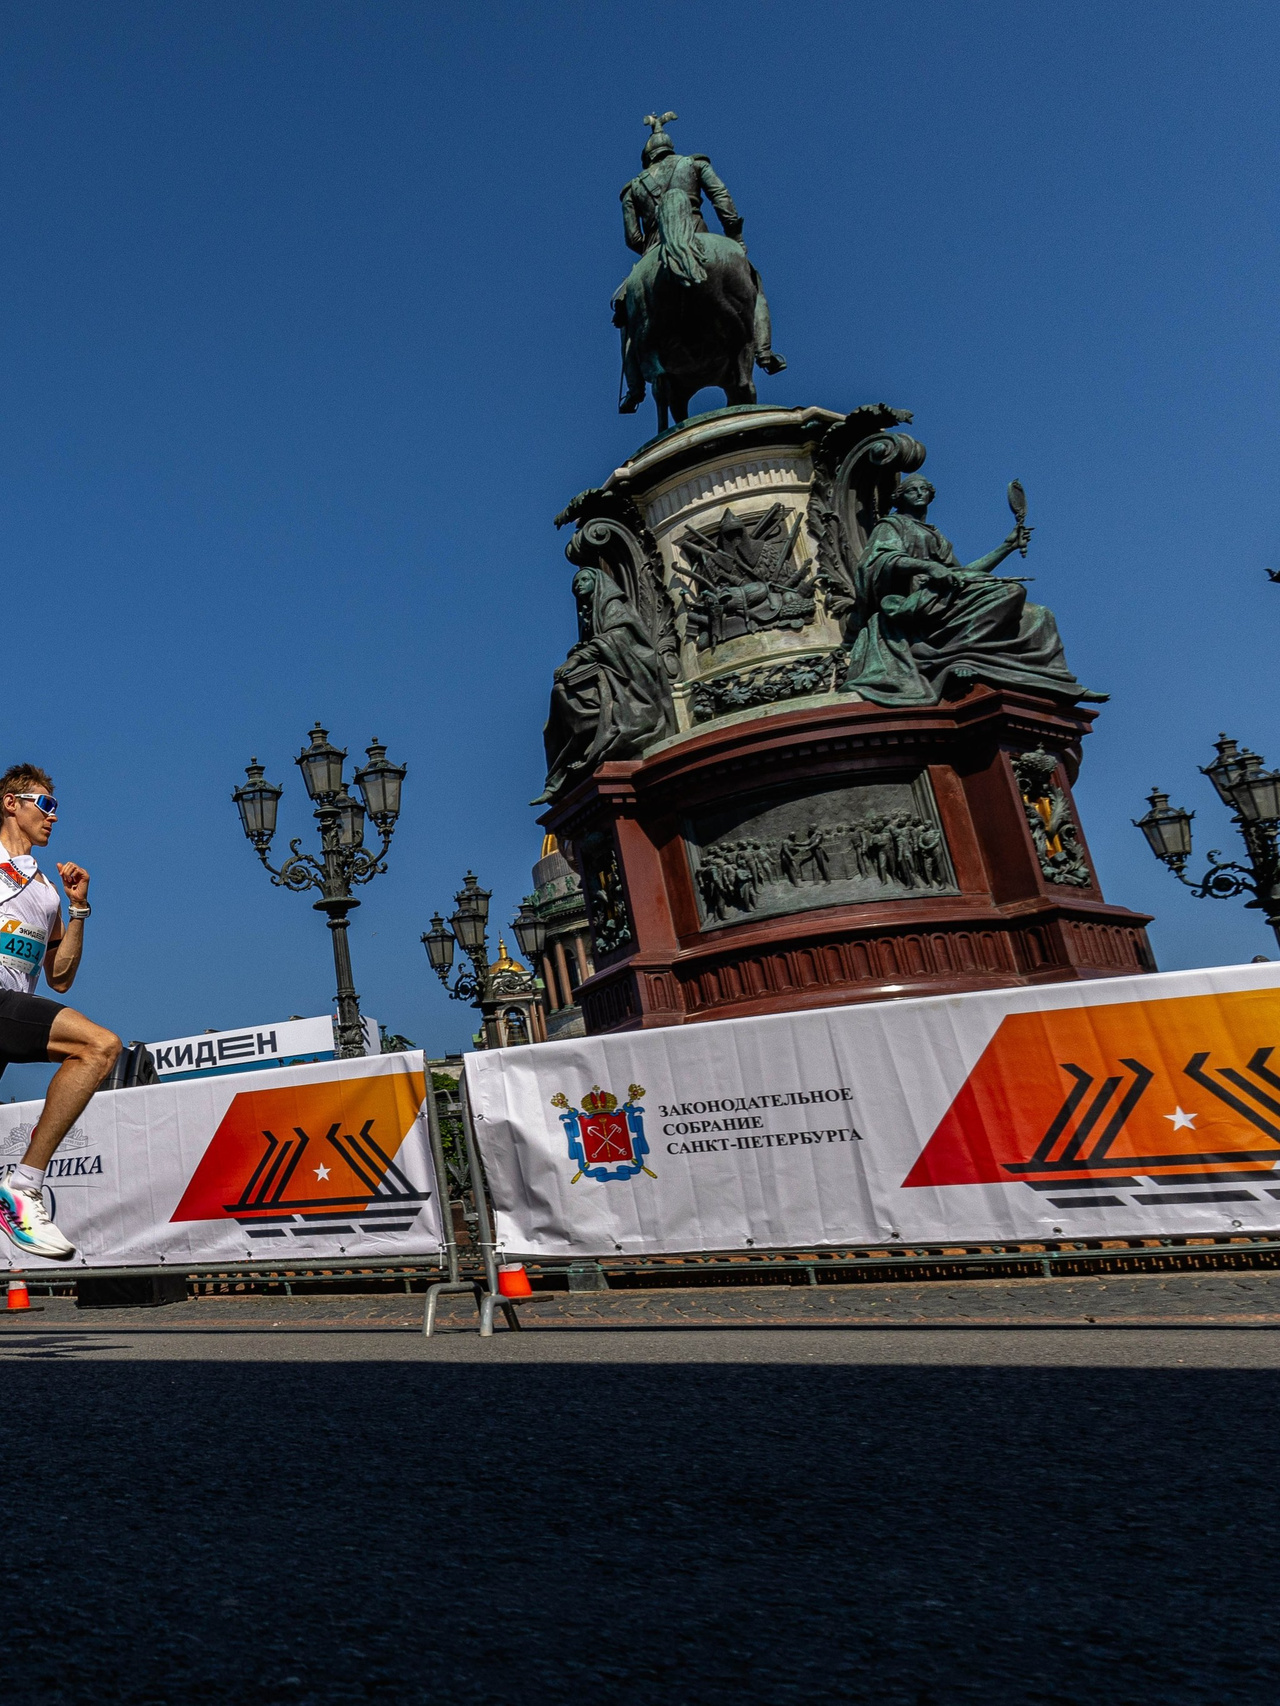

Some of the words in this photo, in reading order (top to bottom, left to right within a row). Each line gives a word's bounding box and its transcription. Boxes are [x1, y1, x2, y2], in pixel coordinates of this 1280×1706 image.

[5, 937, 40, 961] 423-4
[658, 1087, 854, 1118] ЗАКОНОДАТЕЛЬНОЕ
[663, 1115, 764, 1137] СОБРАНИЕ
[666, 1127, 864, 1156] САНКТ-ПЕТЕРБУРГА
[6, 1155, 104, 1178] БТИКА
